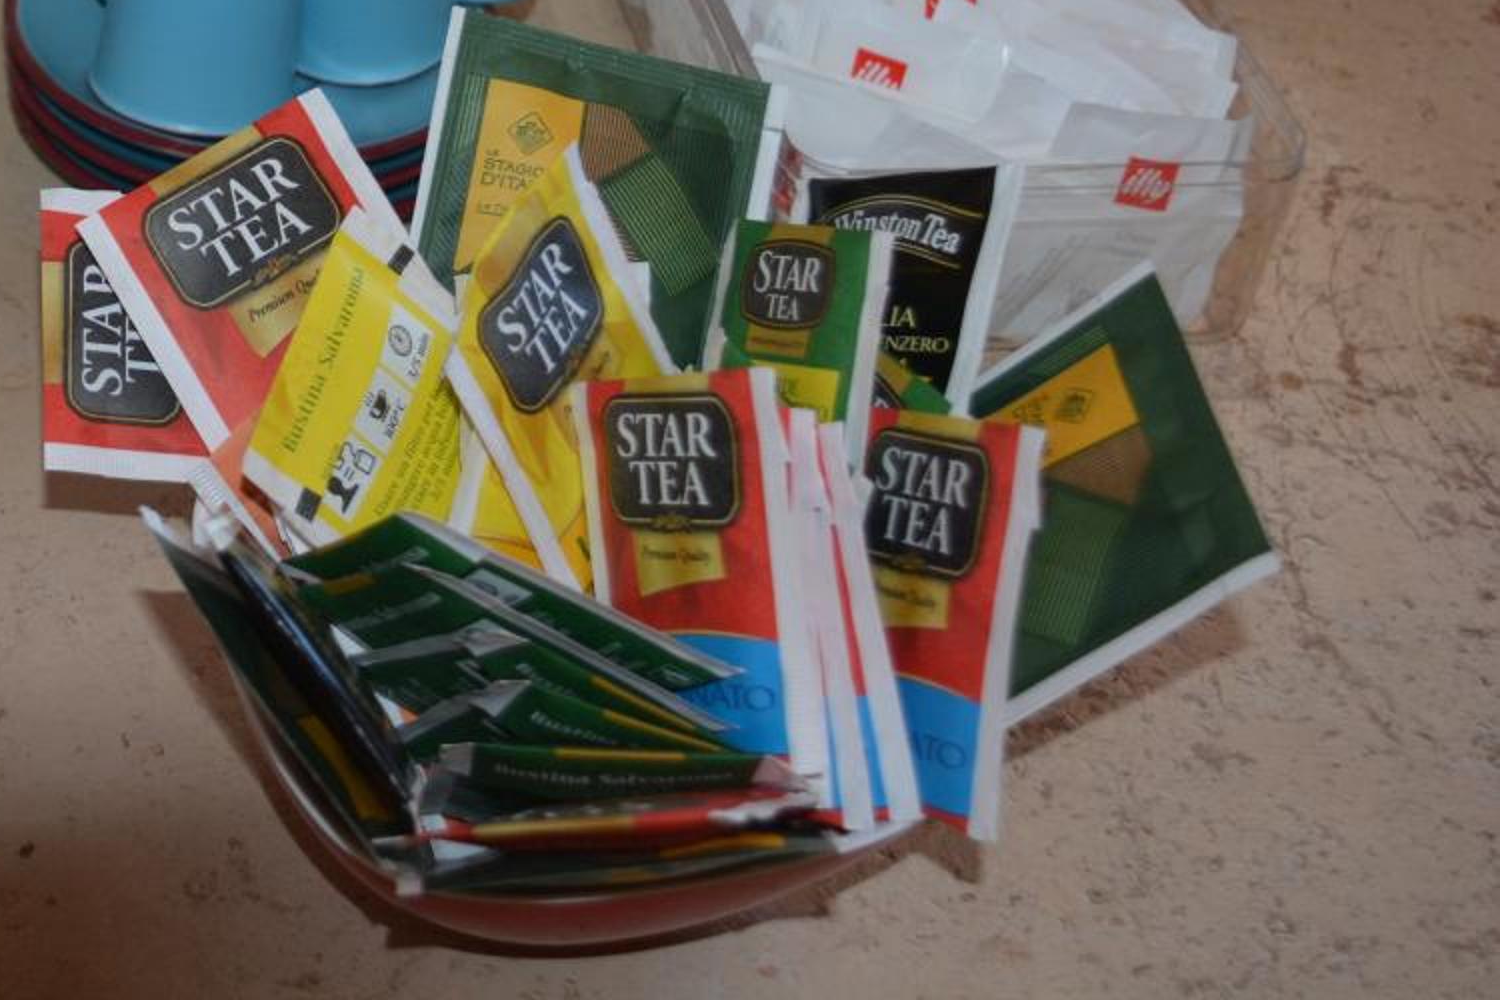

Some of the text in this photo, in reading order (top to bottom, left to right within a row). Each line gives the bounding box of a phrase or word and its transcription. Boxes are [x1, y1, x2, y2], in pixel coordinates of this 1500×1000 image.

[167, 157, 300, 250] STAR
[1123, 166, 1172, 204] illy
[200, 201, 313, 277] TEA
[923, 213, 962, 255] Tea
[753, 250, 821, 293] STAR
[497, 243, 573, 352] STAR
[766, 294, 800, 321] TEA
[525, 289, 589, 375] TEA
[883, 334, 949, 353] NZERO
[616, 412, 716, 458] STAR
[628, 461, 710, 506] TEA
[875, 446, 970, 508] STAR
[883, 494, 951, 555] TEA
